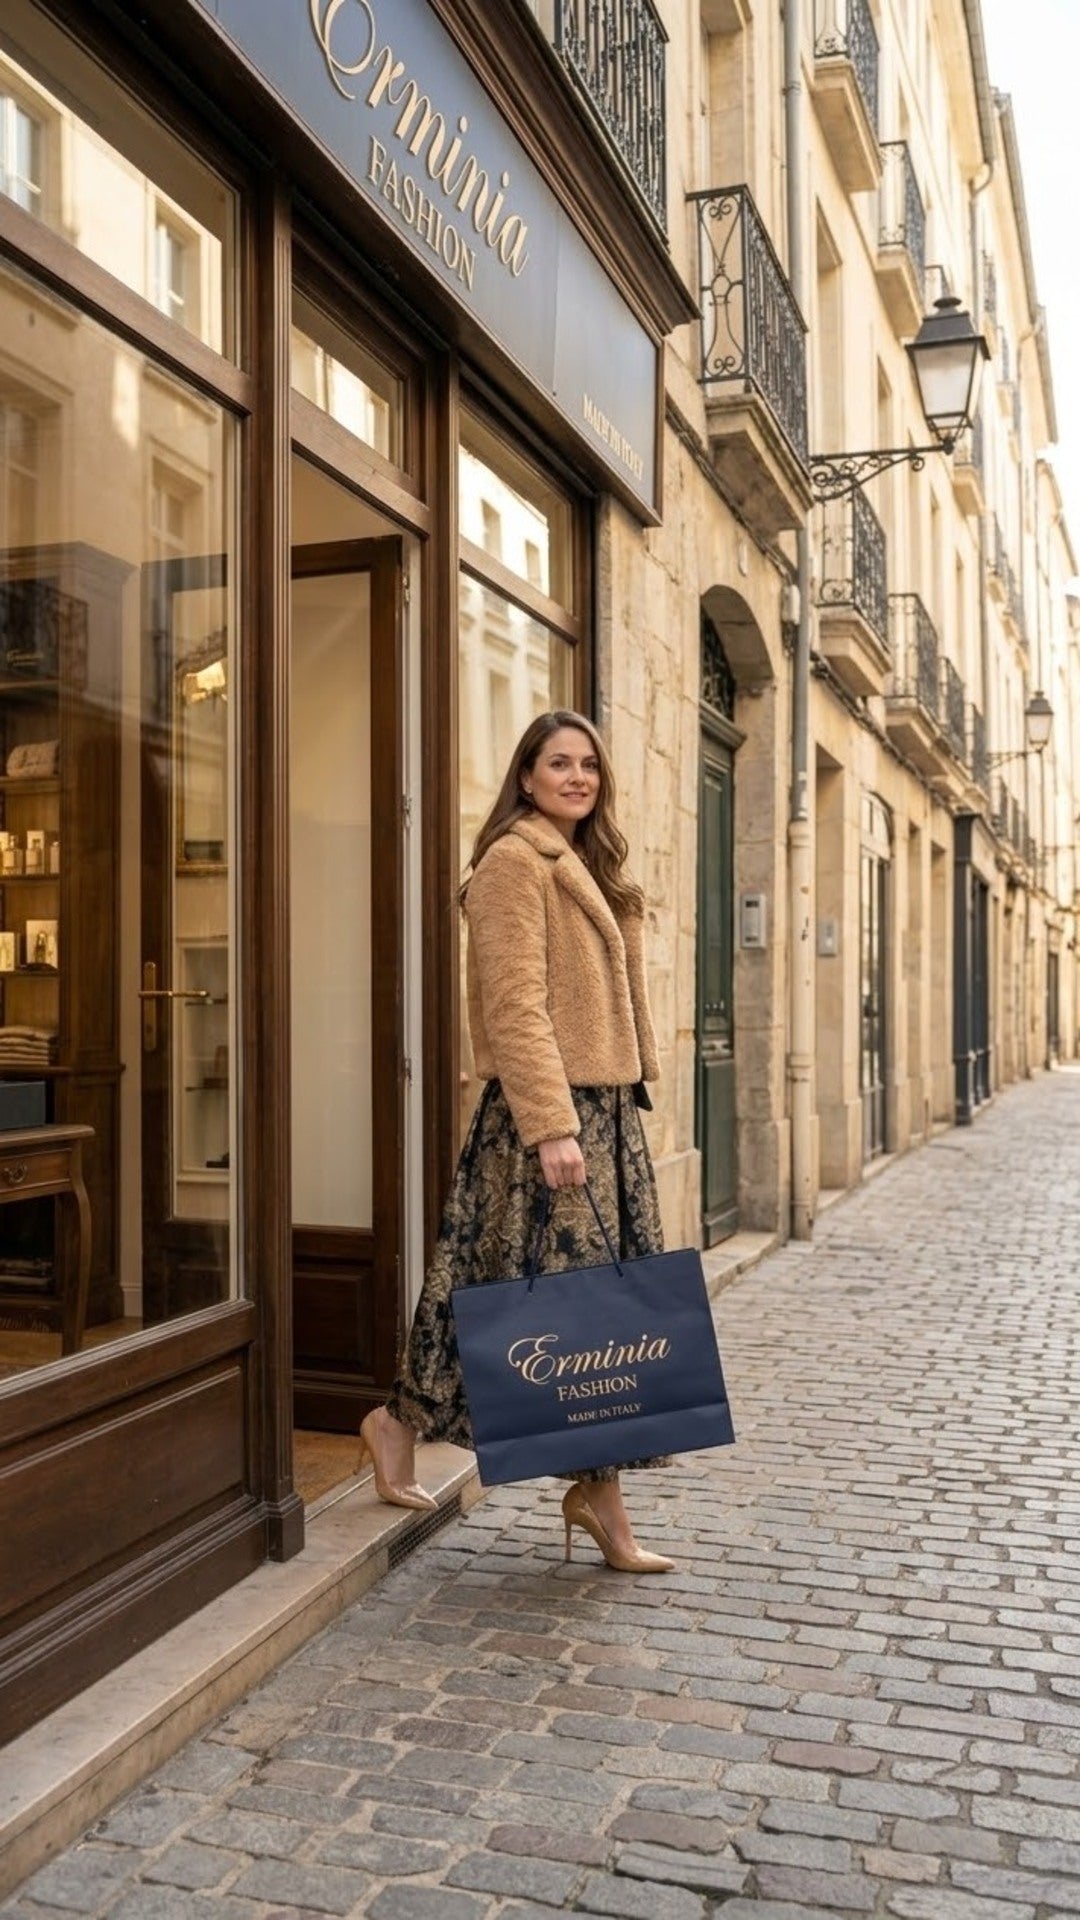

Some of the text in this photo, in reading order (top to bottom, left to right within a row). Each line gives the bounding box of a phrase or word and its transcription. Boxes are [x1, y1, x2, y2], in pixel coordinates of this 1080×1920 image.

[367, 134, 476, 292] FASHION
[508, 1334, 671, 1384] Erminia
[556, 1374, 638, 1402] FASHION
[567, 1410, 598, 1423] MADE
[612, 1402, 643, 1416] ITALY
